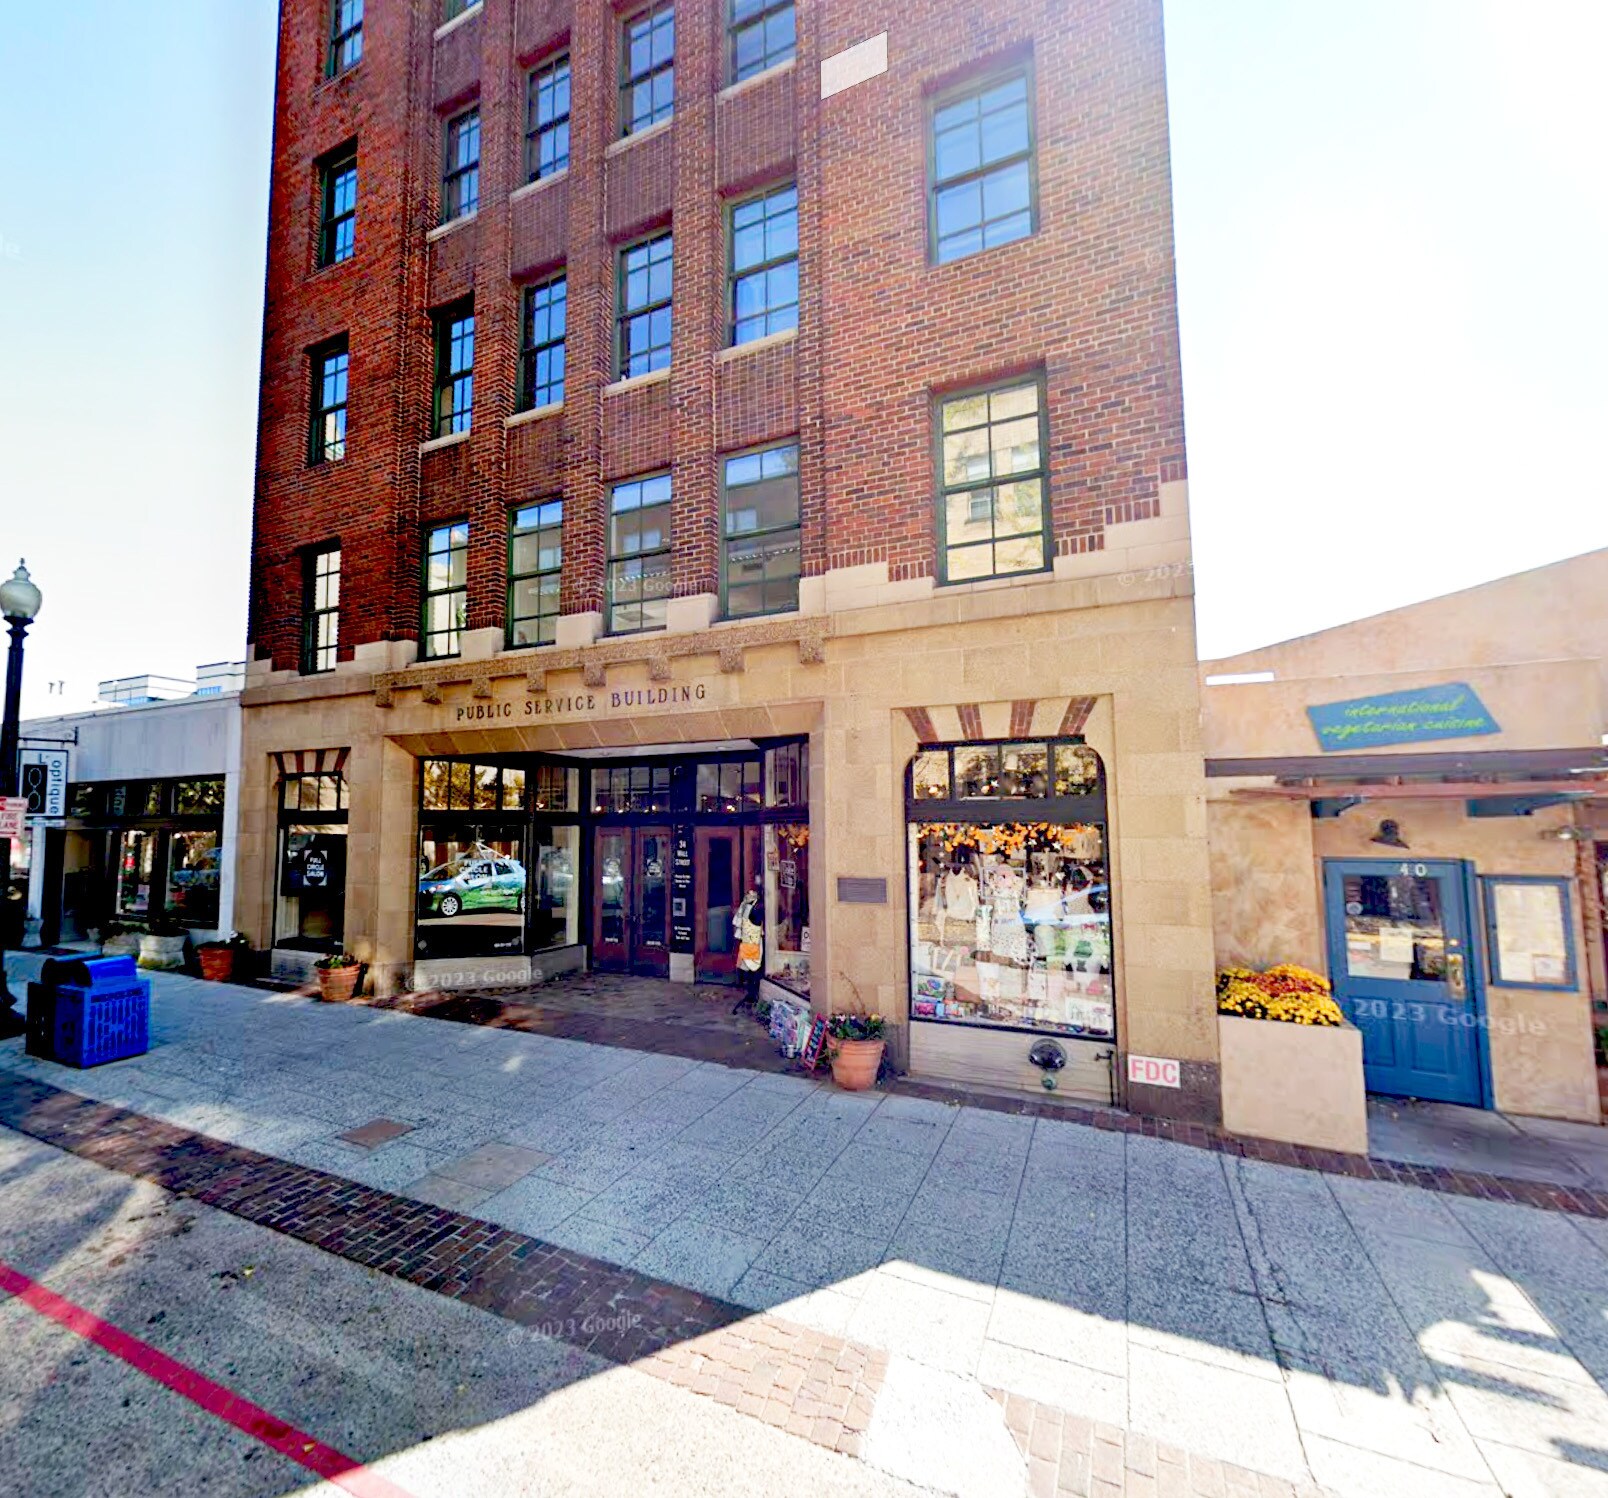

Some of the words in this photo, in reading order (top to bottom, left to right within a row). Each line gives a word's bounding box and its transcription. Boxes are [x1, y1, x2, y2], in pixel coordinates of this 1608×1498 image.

[456, 702, 512, 721] PUBLIC
[524, 695, 596, 715] SERVICE
[611, 684, 706, 708] BUILDING
[1344, 695, 1466, 716] international
[1322, 721, 1417, 740] vegetarian
[1424, 717, 1485, 731] cuisine
[48, 760, 62, 814] optique
[1400, 863, 1428, 877] 40
[1130, 1059, 1177, 1084] FDC
